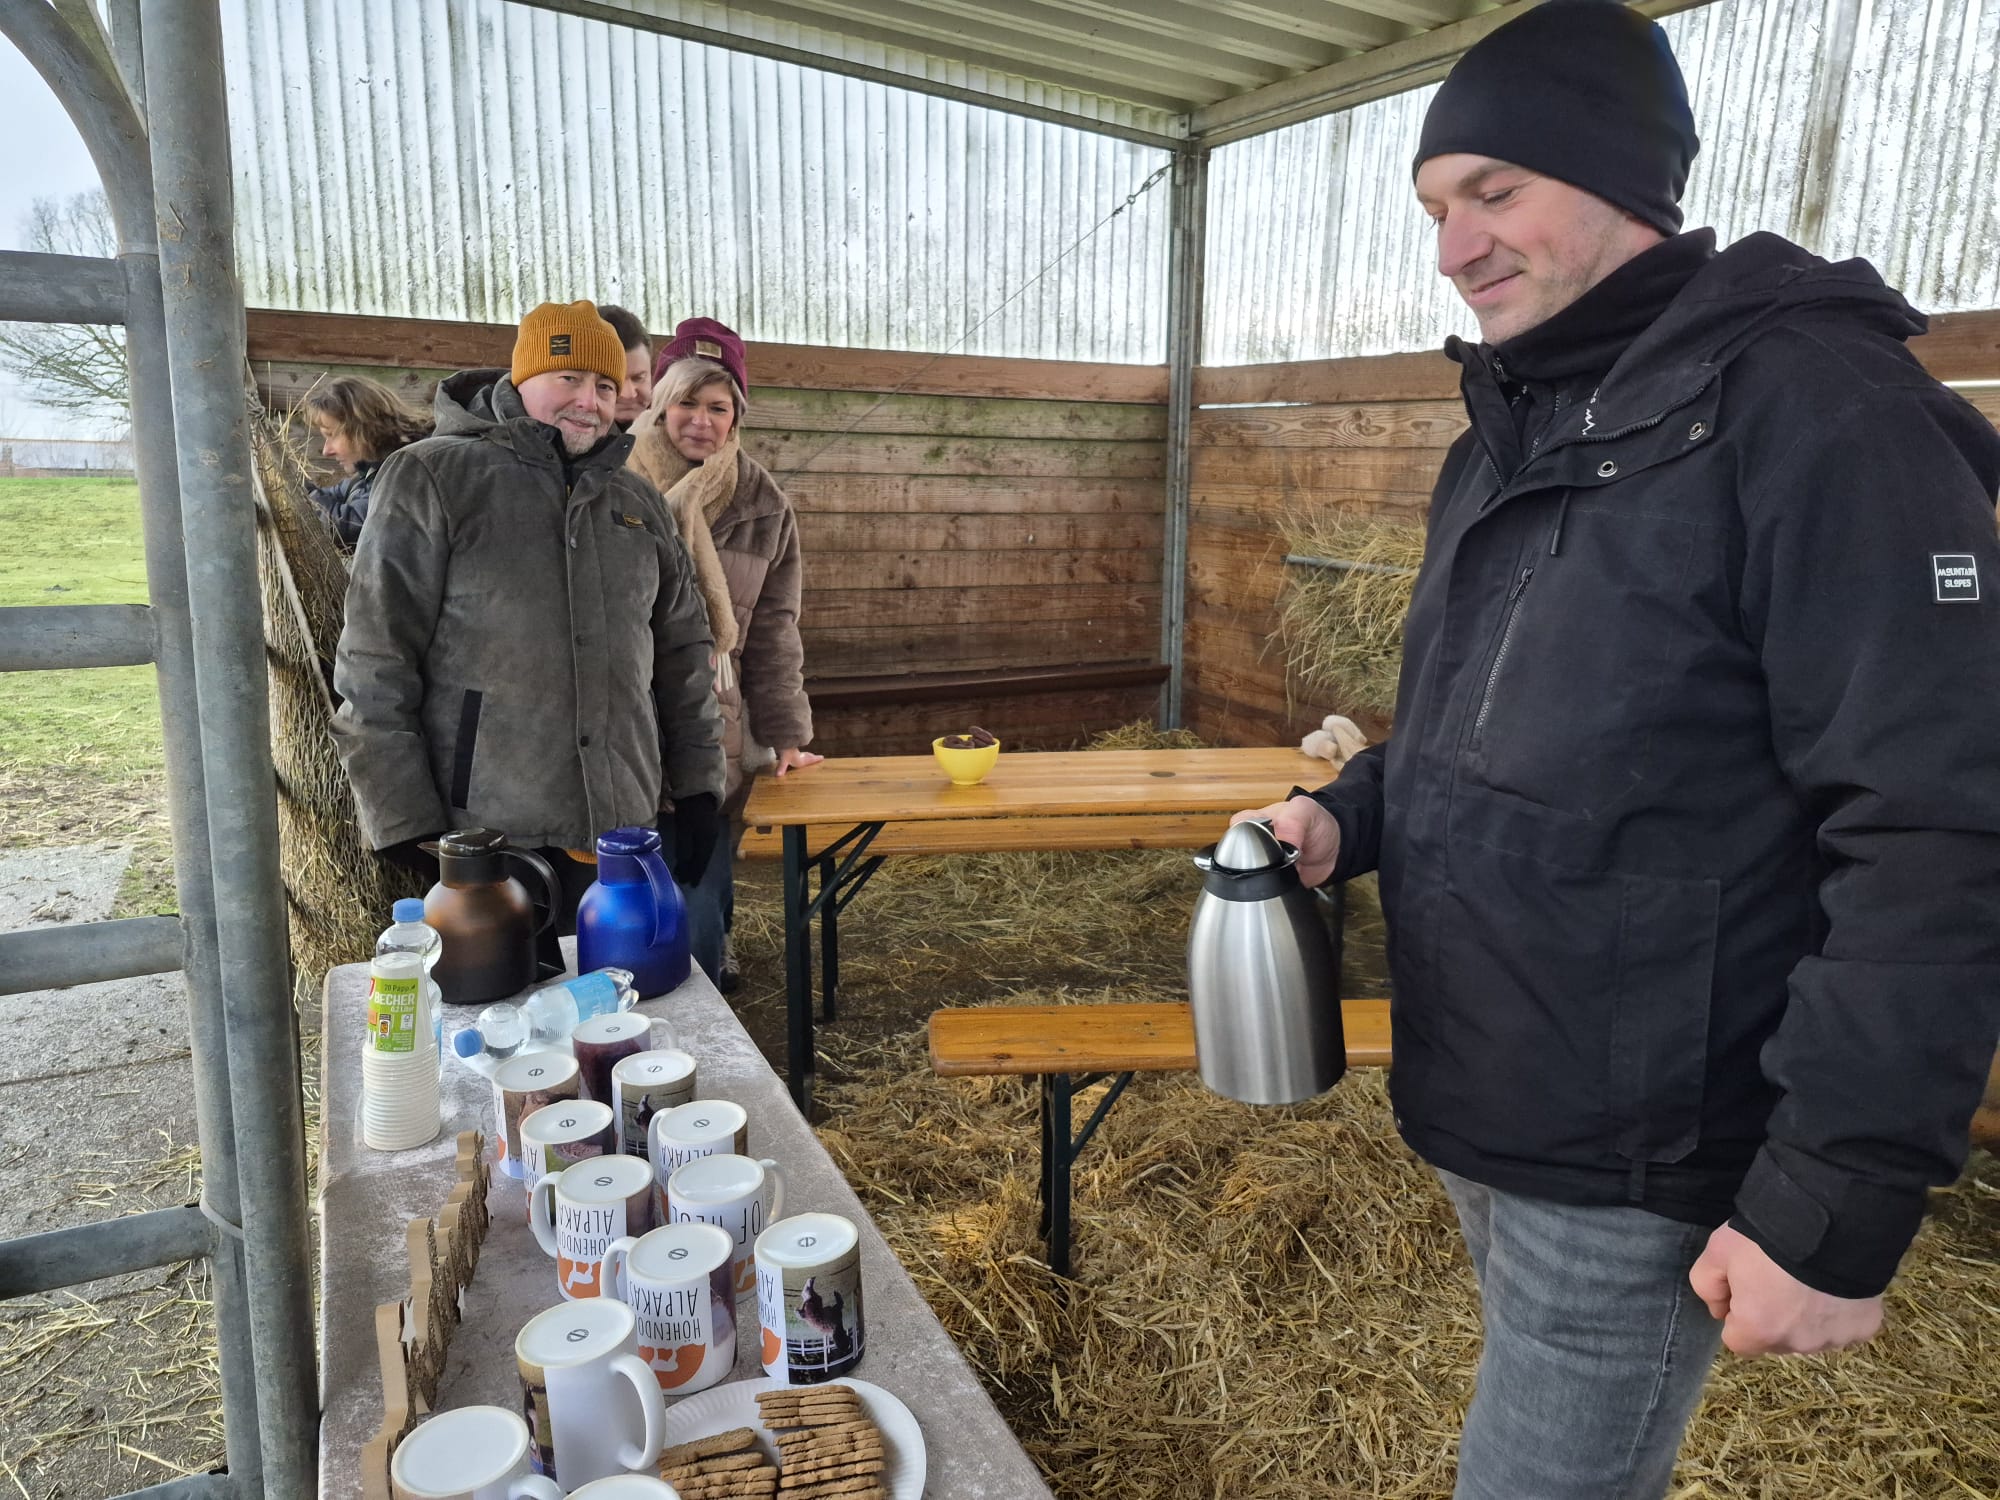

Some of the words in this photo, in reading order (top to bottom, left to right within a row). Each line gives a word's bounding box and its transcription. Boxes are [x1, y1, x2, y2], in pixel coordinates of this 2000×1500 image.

[1944, 579, 1972, 588] SLOPES
[375, 992, 415, 1005] BECHER
[629, 1280, 698, 1318] ALPAKAS
